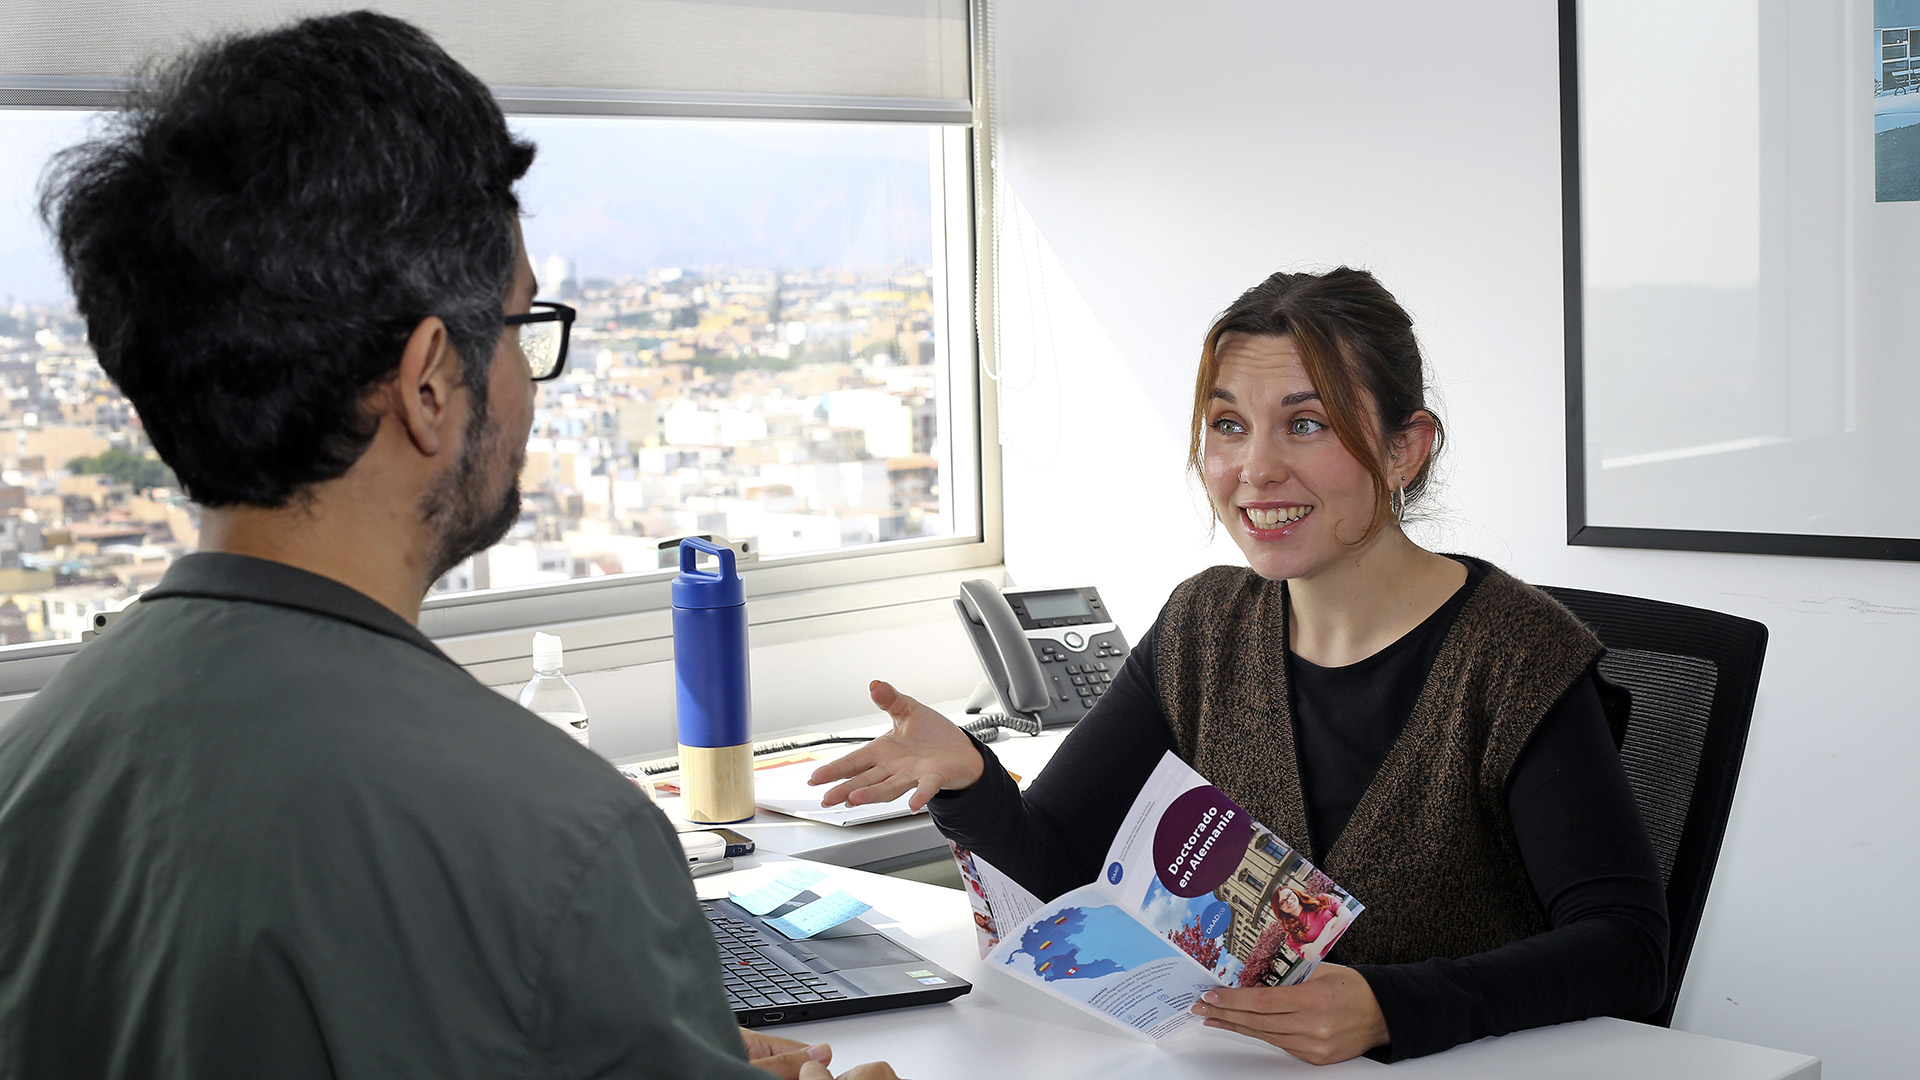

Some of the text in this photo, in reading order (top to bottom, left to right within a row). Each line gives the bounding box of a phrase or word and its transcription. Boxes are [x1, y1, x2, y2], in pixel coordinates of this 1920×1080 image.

[1167, 806, 1218, 876] Doctorado
[1178, 809, 1236, 888] en Alemania
